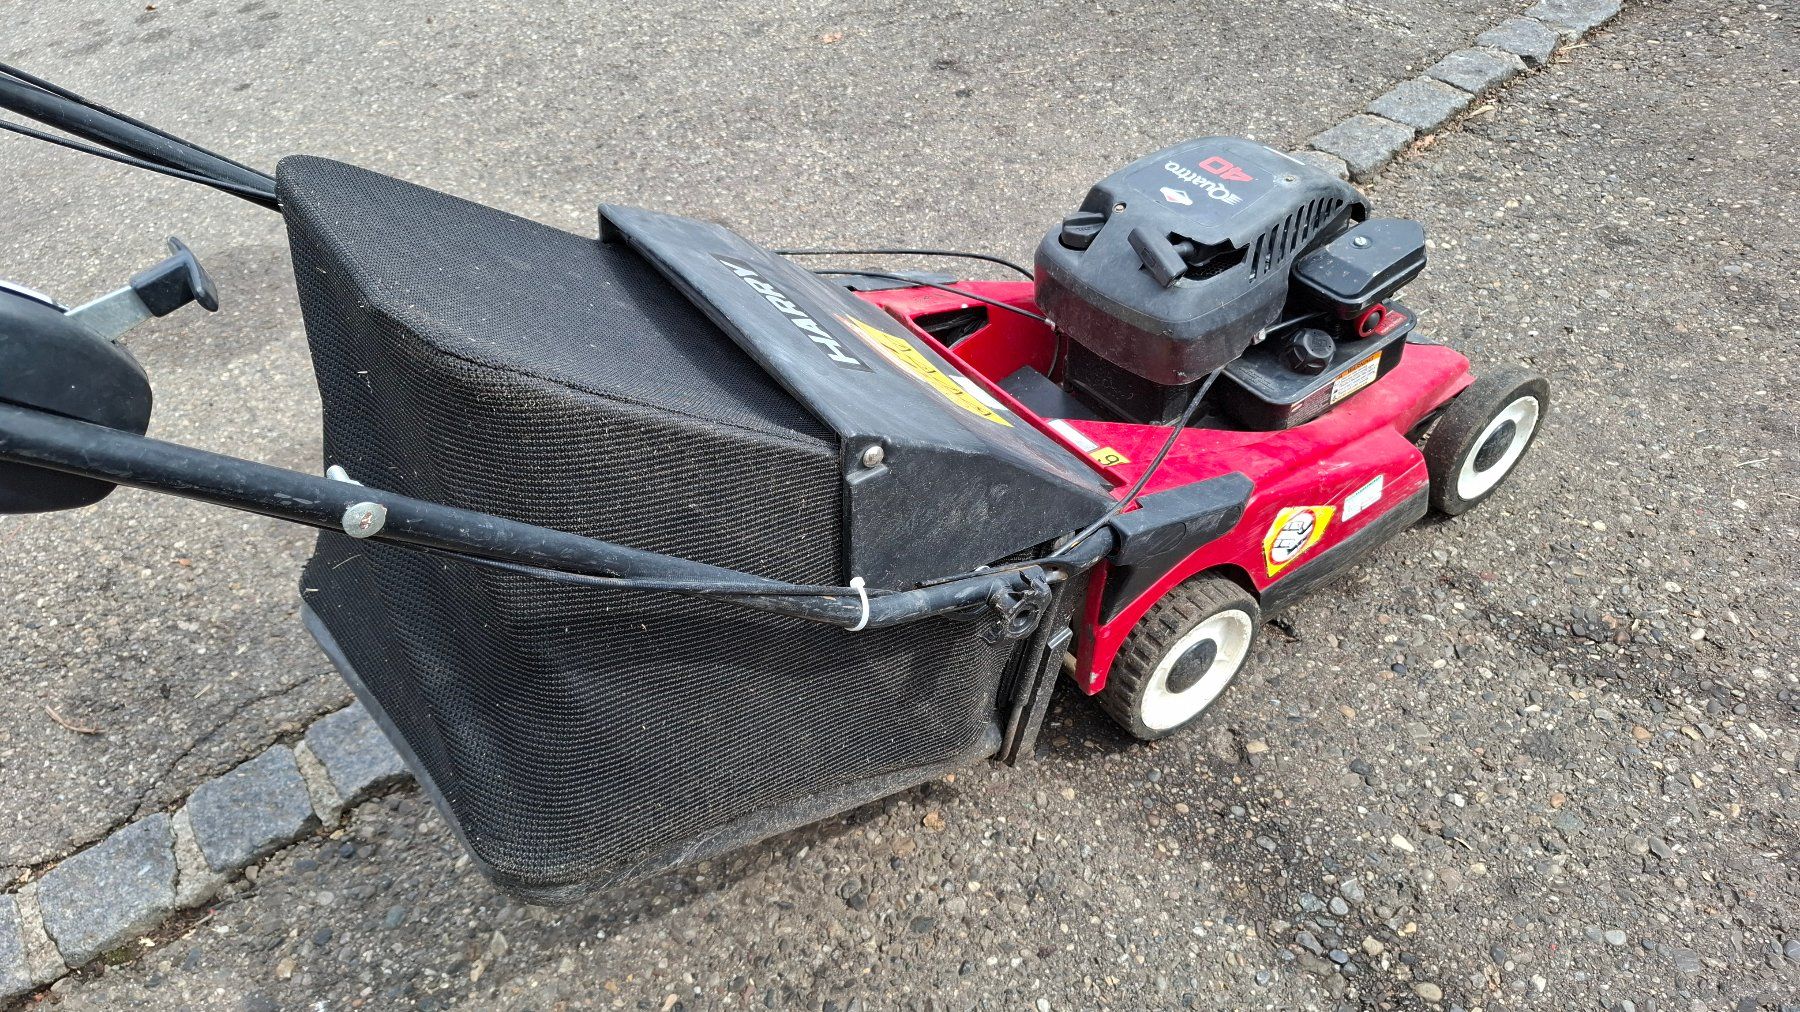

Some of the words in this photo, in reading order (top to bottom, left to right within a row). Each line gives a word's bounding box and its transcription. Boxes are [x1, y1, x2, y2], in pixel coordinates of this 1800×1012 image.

[1164, 161, 1238, 203] Quattro
[1199, 156, 1254, 182] 40
[719, 260, 861, 365] HARRY
